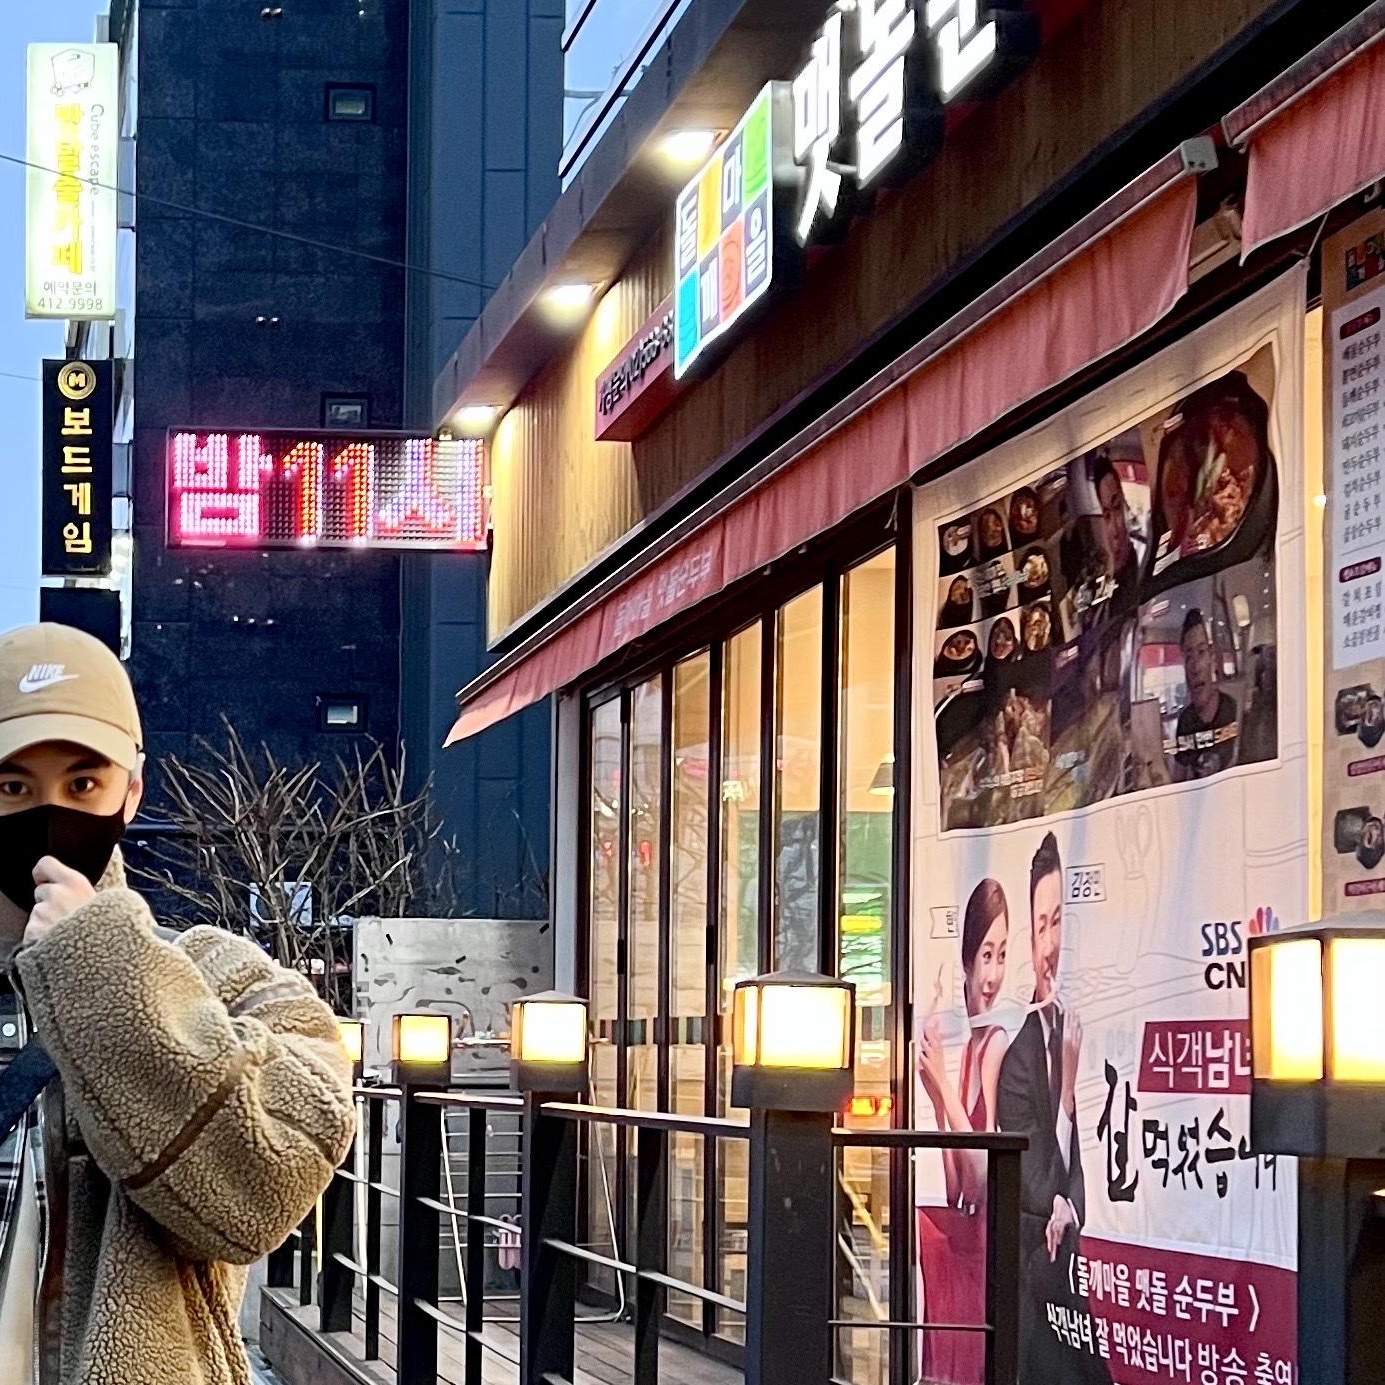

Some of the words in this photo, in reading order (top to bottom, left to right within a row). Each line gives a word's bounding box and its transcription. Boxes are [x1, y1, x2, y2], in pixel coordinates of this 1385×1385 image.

[90, 103, 104, 140] Cube
[90, 143, 100, 196] escape
[44, 281, 97, 297] 예약문의
[61, 407, 93, 555] 보드게임
[28, 664, 65, 681] NIKE
[1201, 920, 1244, 957] SBS
[1204, 960, 1247, 990] CN
[1173, 1275, 1240, 1327] 순두부
[1046, 1302, 1095, 1355] 식객남녀
[1094, 1317, 1111, 1359] 잘
[1112, 1321, 1193, 1383] 먹었습니다
